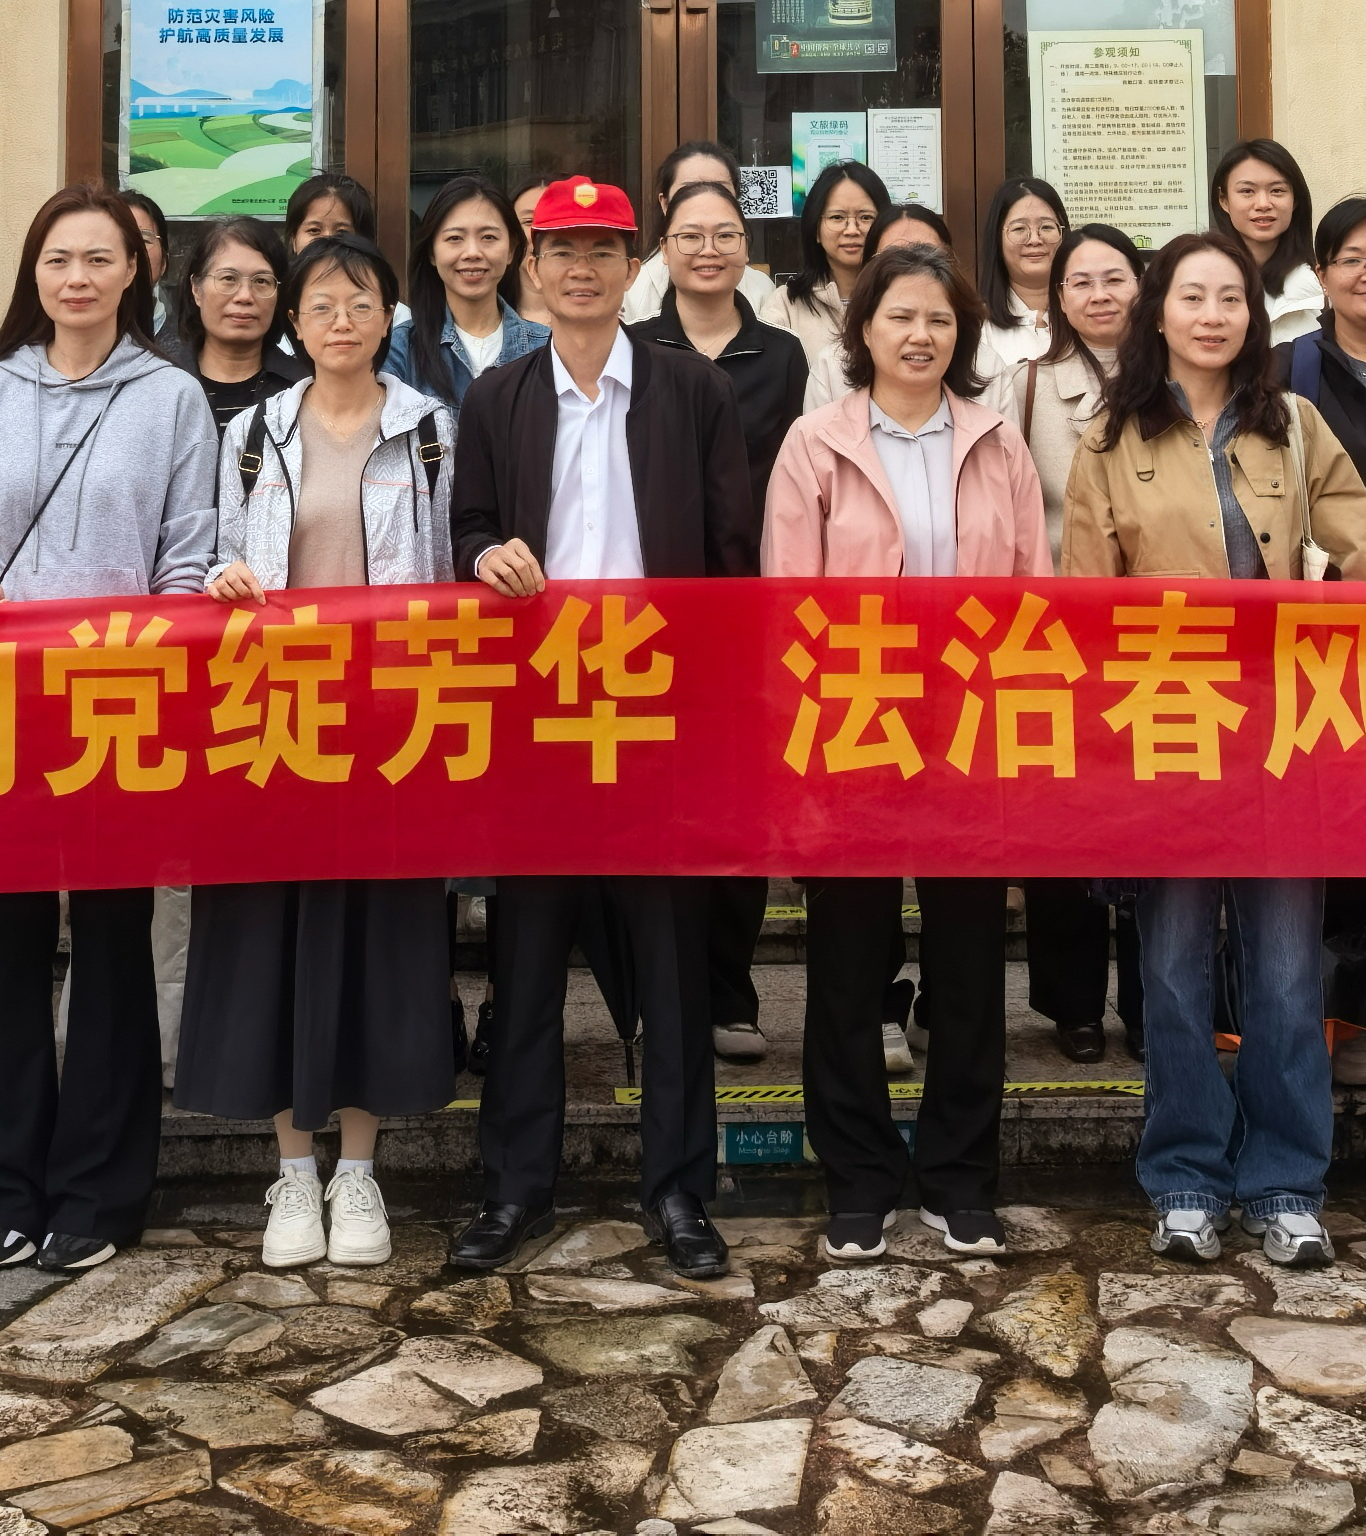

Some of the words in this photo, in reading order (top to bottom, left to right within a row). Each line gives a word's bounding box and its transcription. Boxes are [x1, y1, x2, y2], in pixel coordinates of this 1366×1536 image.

[167, 7, 275, 24] 防范灾害风险
[159, 27, 284, 44] 护航高质量发展
[1093, 47, 1140, 58] 参观须知
[736, 1130, 794, 1145] 小心台阶
